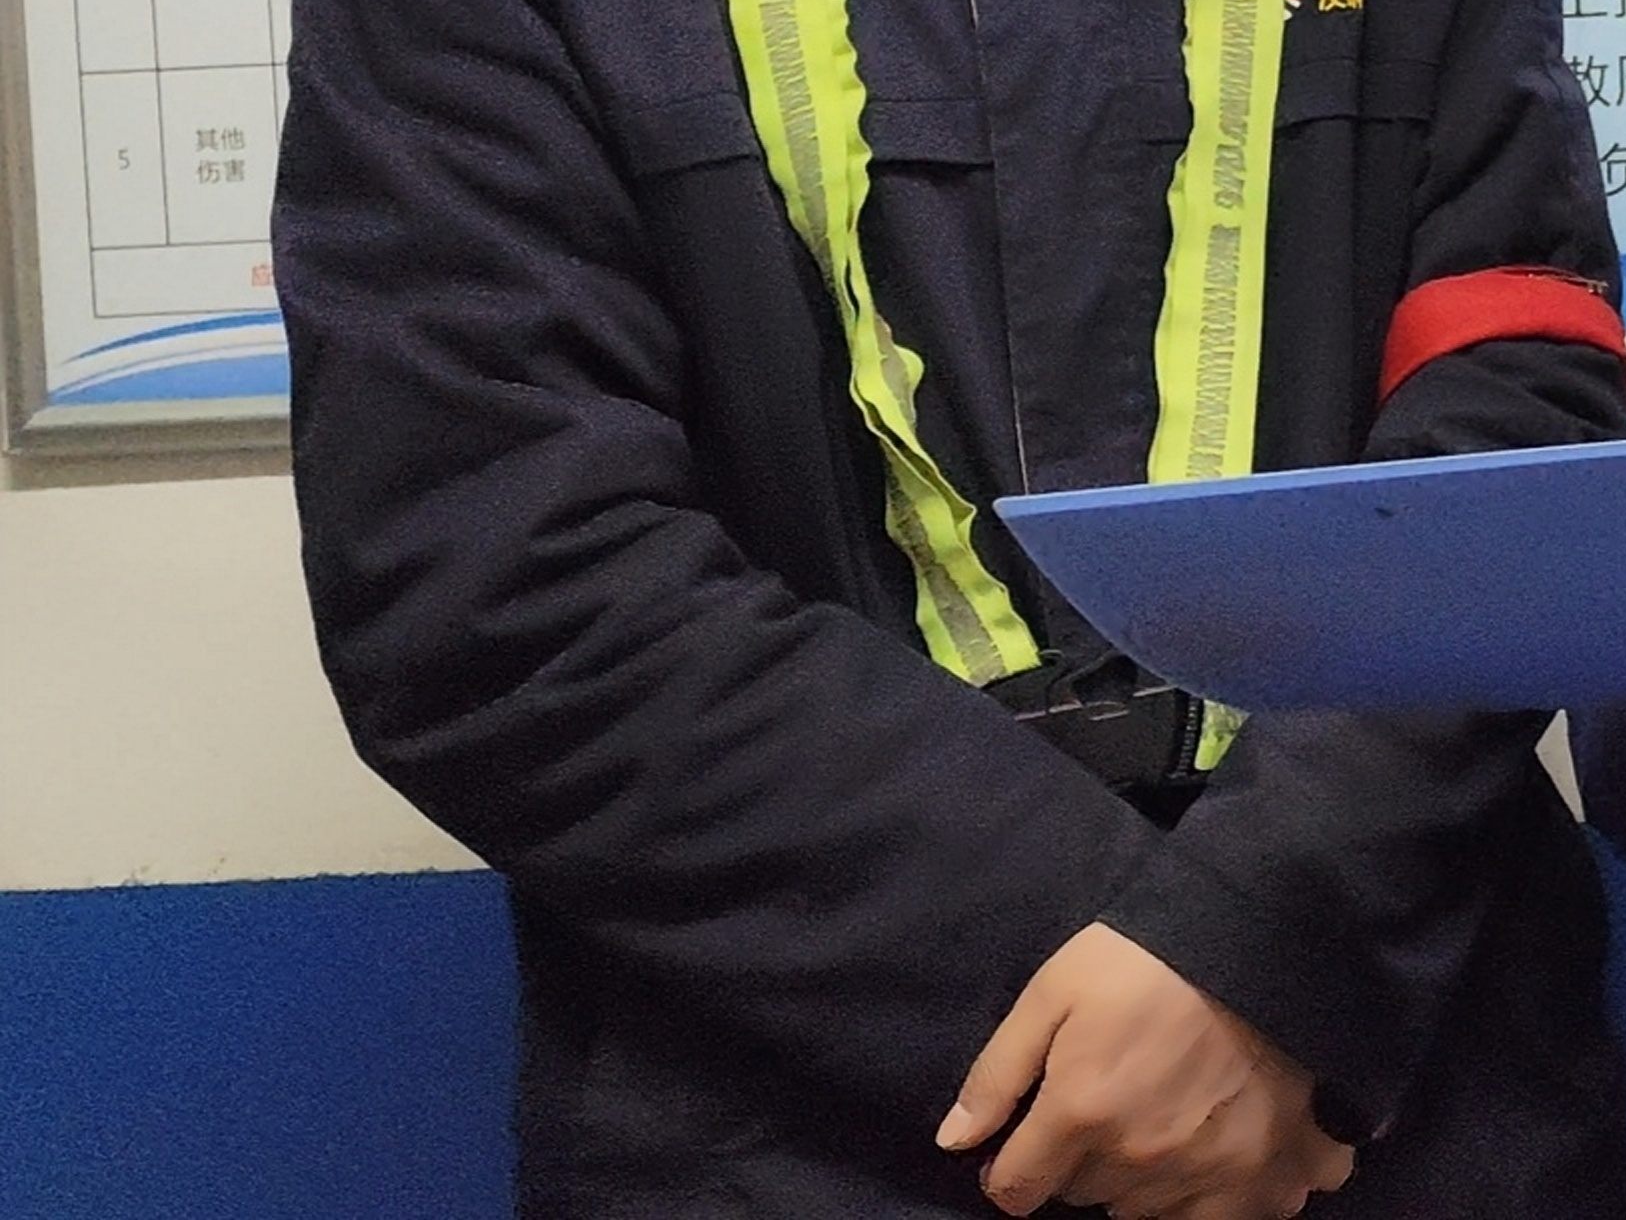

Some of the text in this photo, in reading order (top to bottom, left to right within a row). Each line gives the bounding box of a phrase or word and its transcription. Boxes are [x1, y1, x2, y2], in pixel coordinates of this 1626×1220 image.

[195, 128, 246, 151] 其他
[118, 149, 130, 170] 5
[196, 158, 246, 183] 伤害
